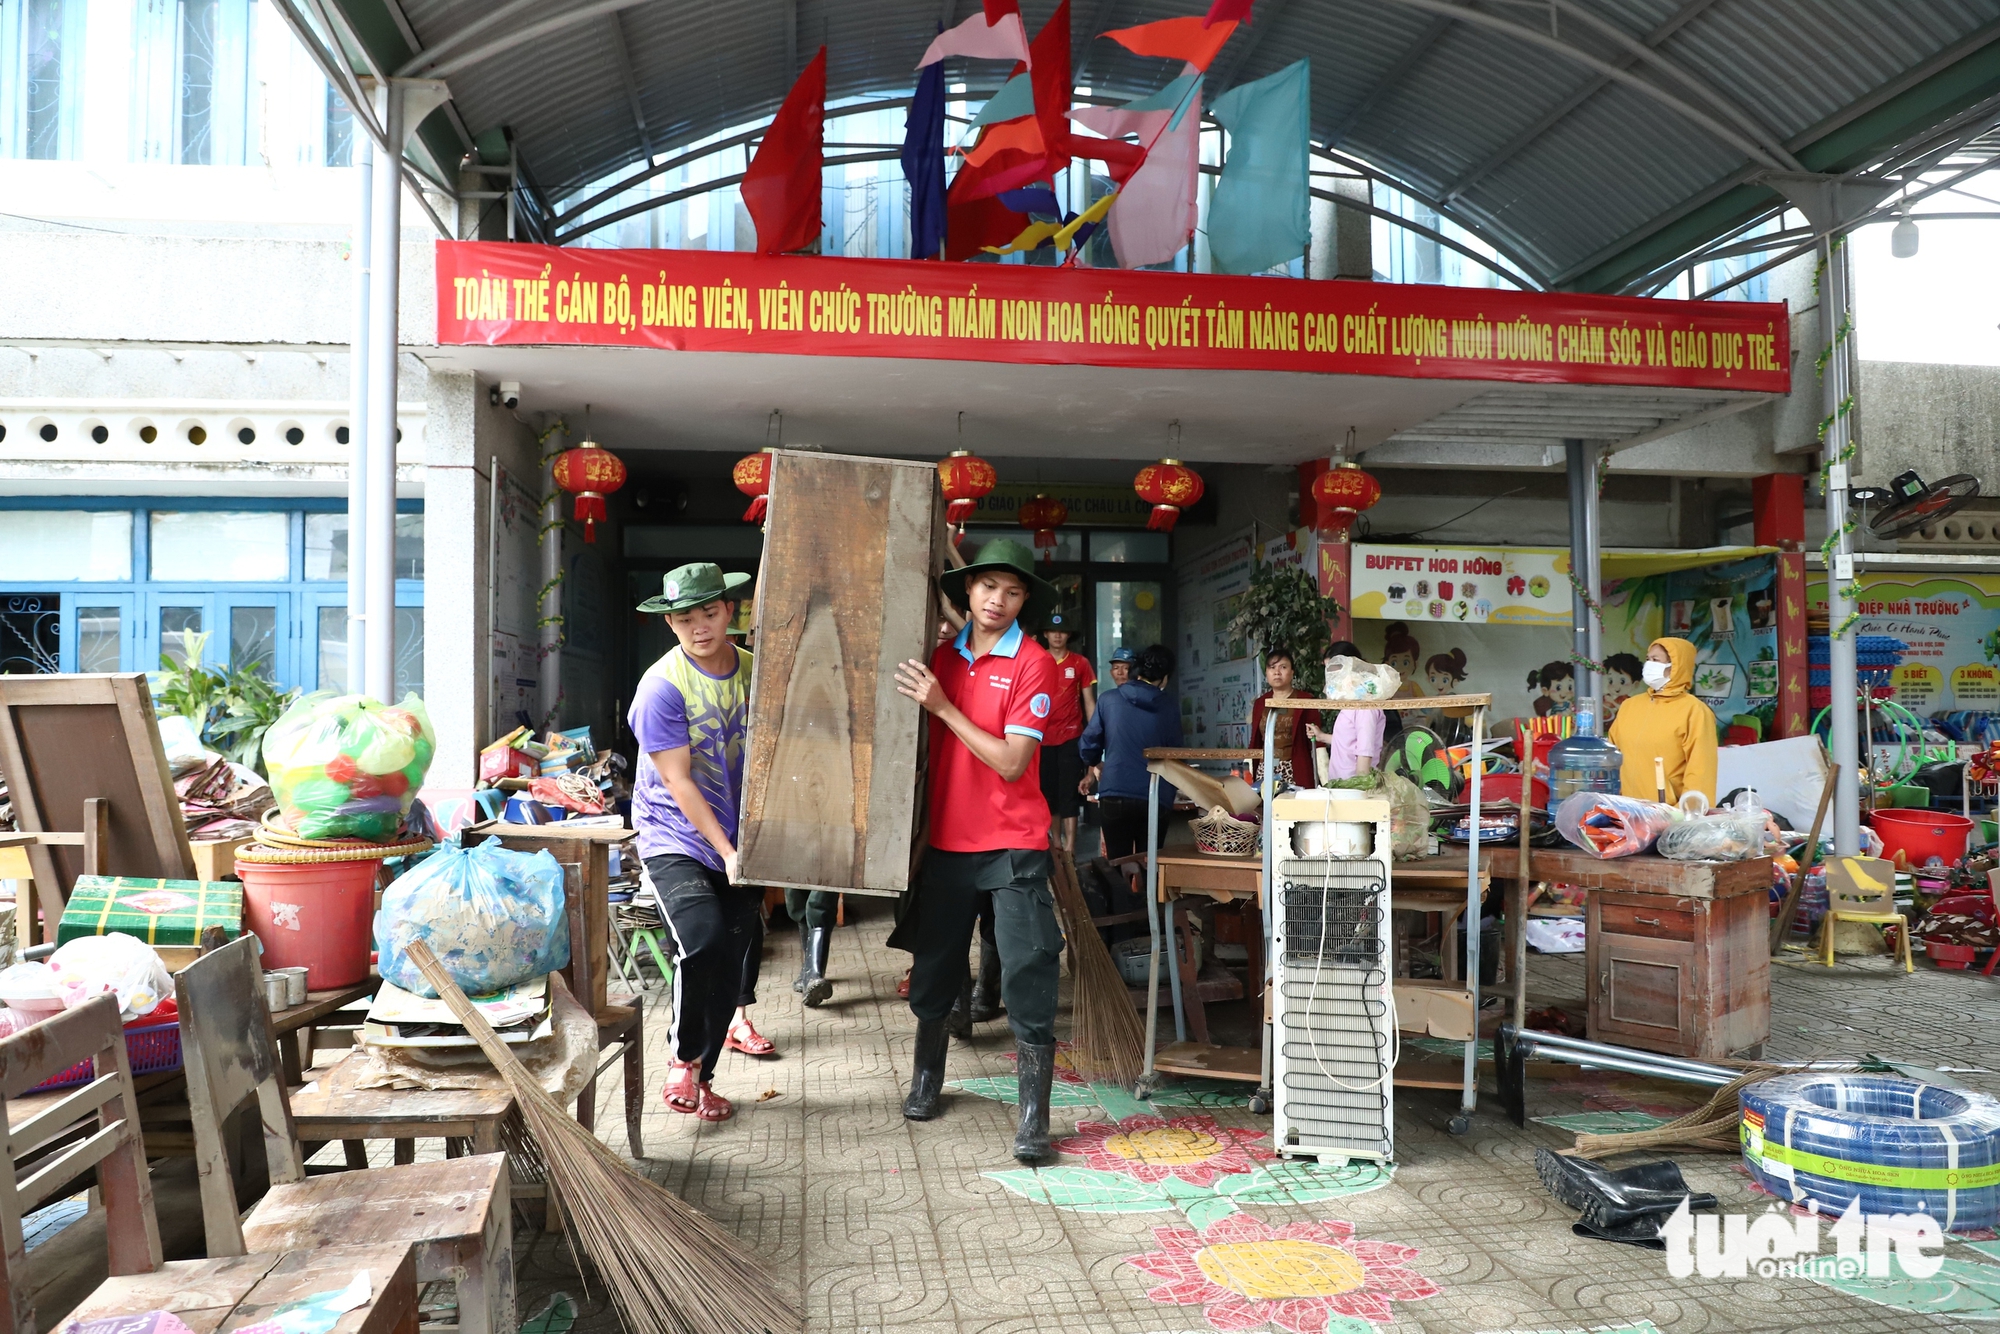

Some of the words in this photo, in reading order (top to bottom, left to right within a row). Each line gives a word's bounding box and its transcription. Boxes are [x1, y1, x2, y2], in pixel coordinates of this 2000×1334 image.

[454, 269, 507, 321] TOÀN
[513, 263, 552, 322] THỂ
[556, 272, 598, 324] CÁN
[603, 274, 636, 334] BỘ,
[642, 270, 697, 328] ĐẢNG
[702, 278, 753, 335] VIÊN,
[759, 280, 803, 331] VIÊN
[809, 283, 861, 334] CHỨC
[867, 284, 942, 337] TRƯỜNG
[948, 283, 996, 339] MẦM
[1001, 300, 1042, 341] NON
[1047, 301, 1084, 343] HOA
[1089, 290, 1140, 345] HỒNG
[1145, 294, 1201, 350] QUYẾT
[1205, 301, 1244, 349] TÂM
[1249, 303, 1299, 351] NÂNG
[1304, 312, 1338, 353] CAO
[1343, 302, 1387, 354] CHẤT
[1392, 314, 1447, 365] LƯỢNG
[1452, 313, 1492, 360] NUÔI
[1497, 314, 1553, 362] DƯỠNG
[1557, 318, 1605, 364] CHĂM
[1609, 320, 1641, 366] SÓC
[1646, 322, 1667, 367] VÀ
[1671, 323, 1708, 369] GIÁO
[1712, 332, 1743, 378] DỤC
[1747, 321, 1781, 371] TRẺ.
[988, 493, 1014, 511] GIÁO
[1085, 496, 1114, 513] CHÁU
[1118, 497, 1131, 514] LÀ
[1366, 555, 1424, 571] BUFFET
[1429, 558, 1458, 573] HOA
[1463, 556, 1502, 576] HỒNG
[1858, 601, 1884, 617] ĐIỆP
[1888, 599, 1911, 615] NHÀ
[1915, 599, 1960, 615] TRƯỜNG
[1903, 669, 1909, 679] 5
[1911, 667, 1928, 679] BIẾT
[1960, 669, 1965, 679] 3
[1966, 668, 1993, 679] KHÔNG
